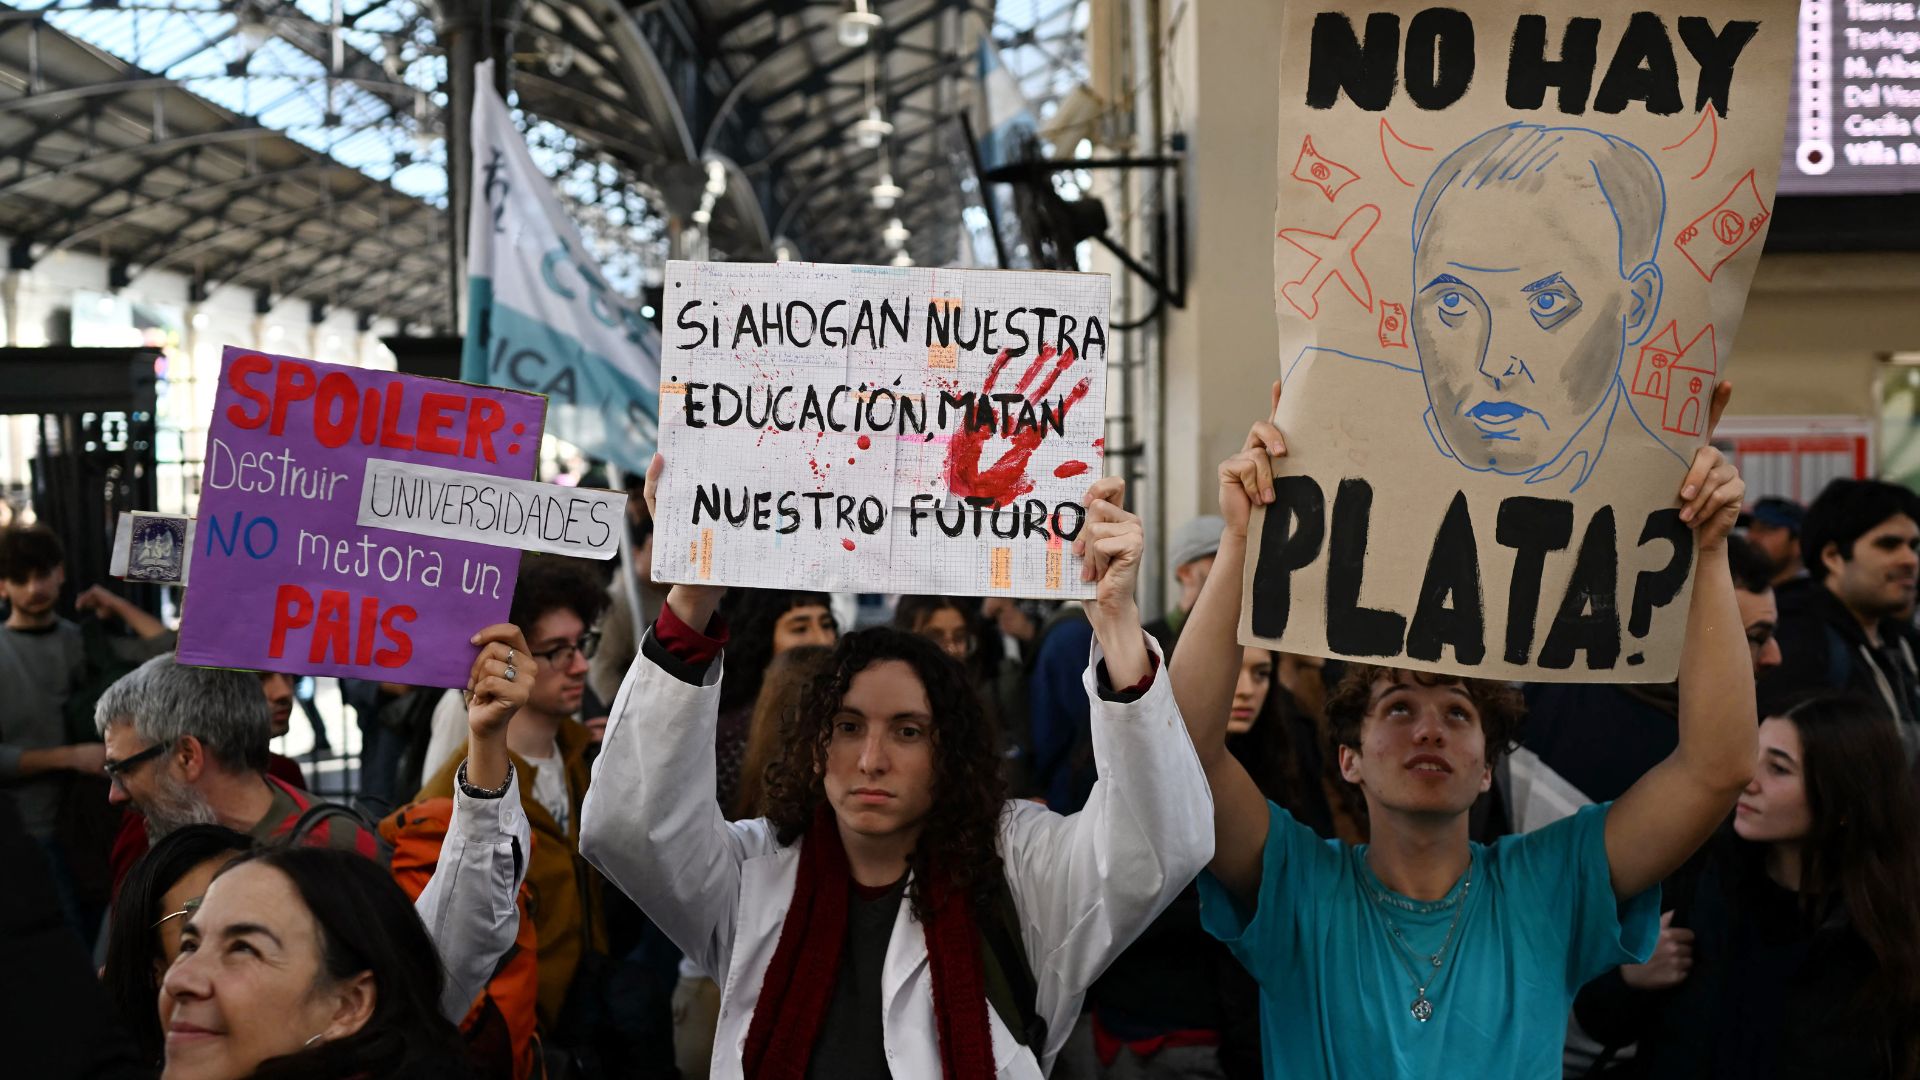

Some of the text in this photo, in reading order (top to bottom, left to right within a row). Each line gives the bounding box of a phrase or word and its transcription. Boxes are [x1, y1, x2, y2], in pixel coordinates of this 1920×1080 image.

[1305, 7, 1762, 118] NO HAY
[731, 295, 911, 350] AHOGAN
[925, 301, 1106, 361] NUESTRA
[226, 353, 526, 464] SPOILER:
[937, 390, 1066, 440] MATAN
[208, 437, 349, 501] Destruir
[370, 473, 611, 548] UNIVERSIDADES
[691, 482, 1087, 542] NUESTRO FUTURO
[205, 510, 279, 560] NO
[461, 557, 501, 600] un
[1251, 473, 1695, 669] PLATA?
[267, 583, 418, 669] PAIS
